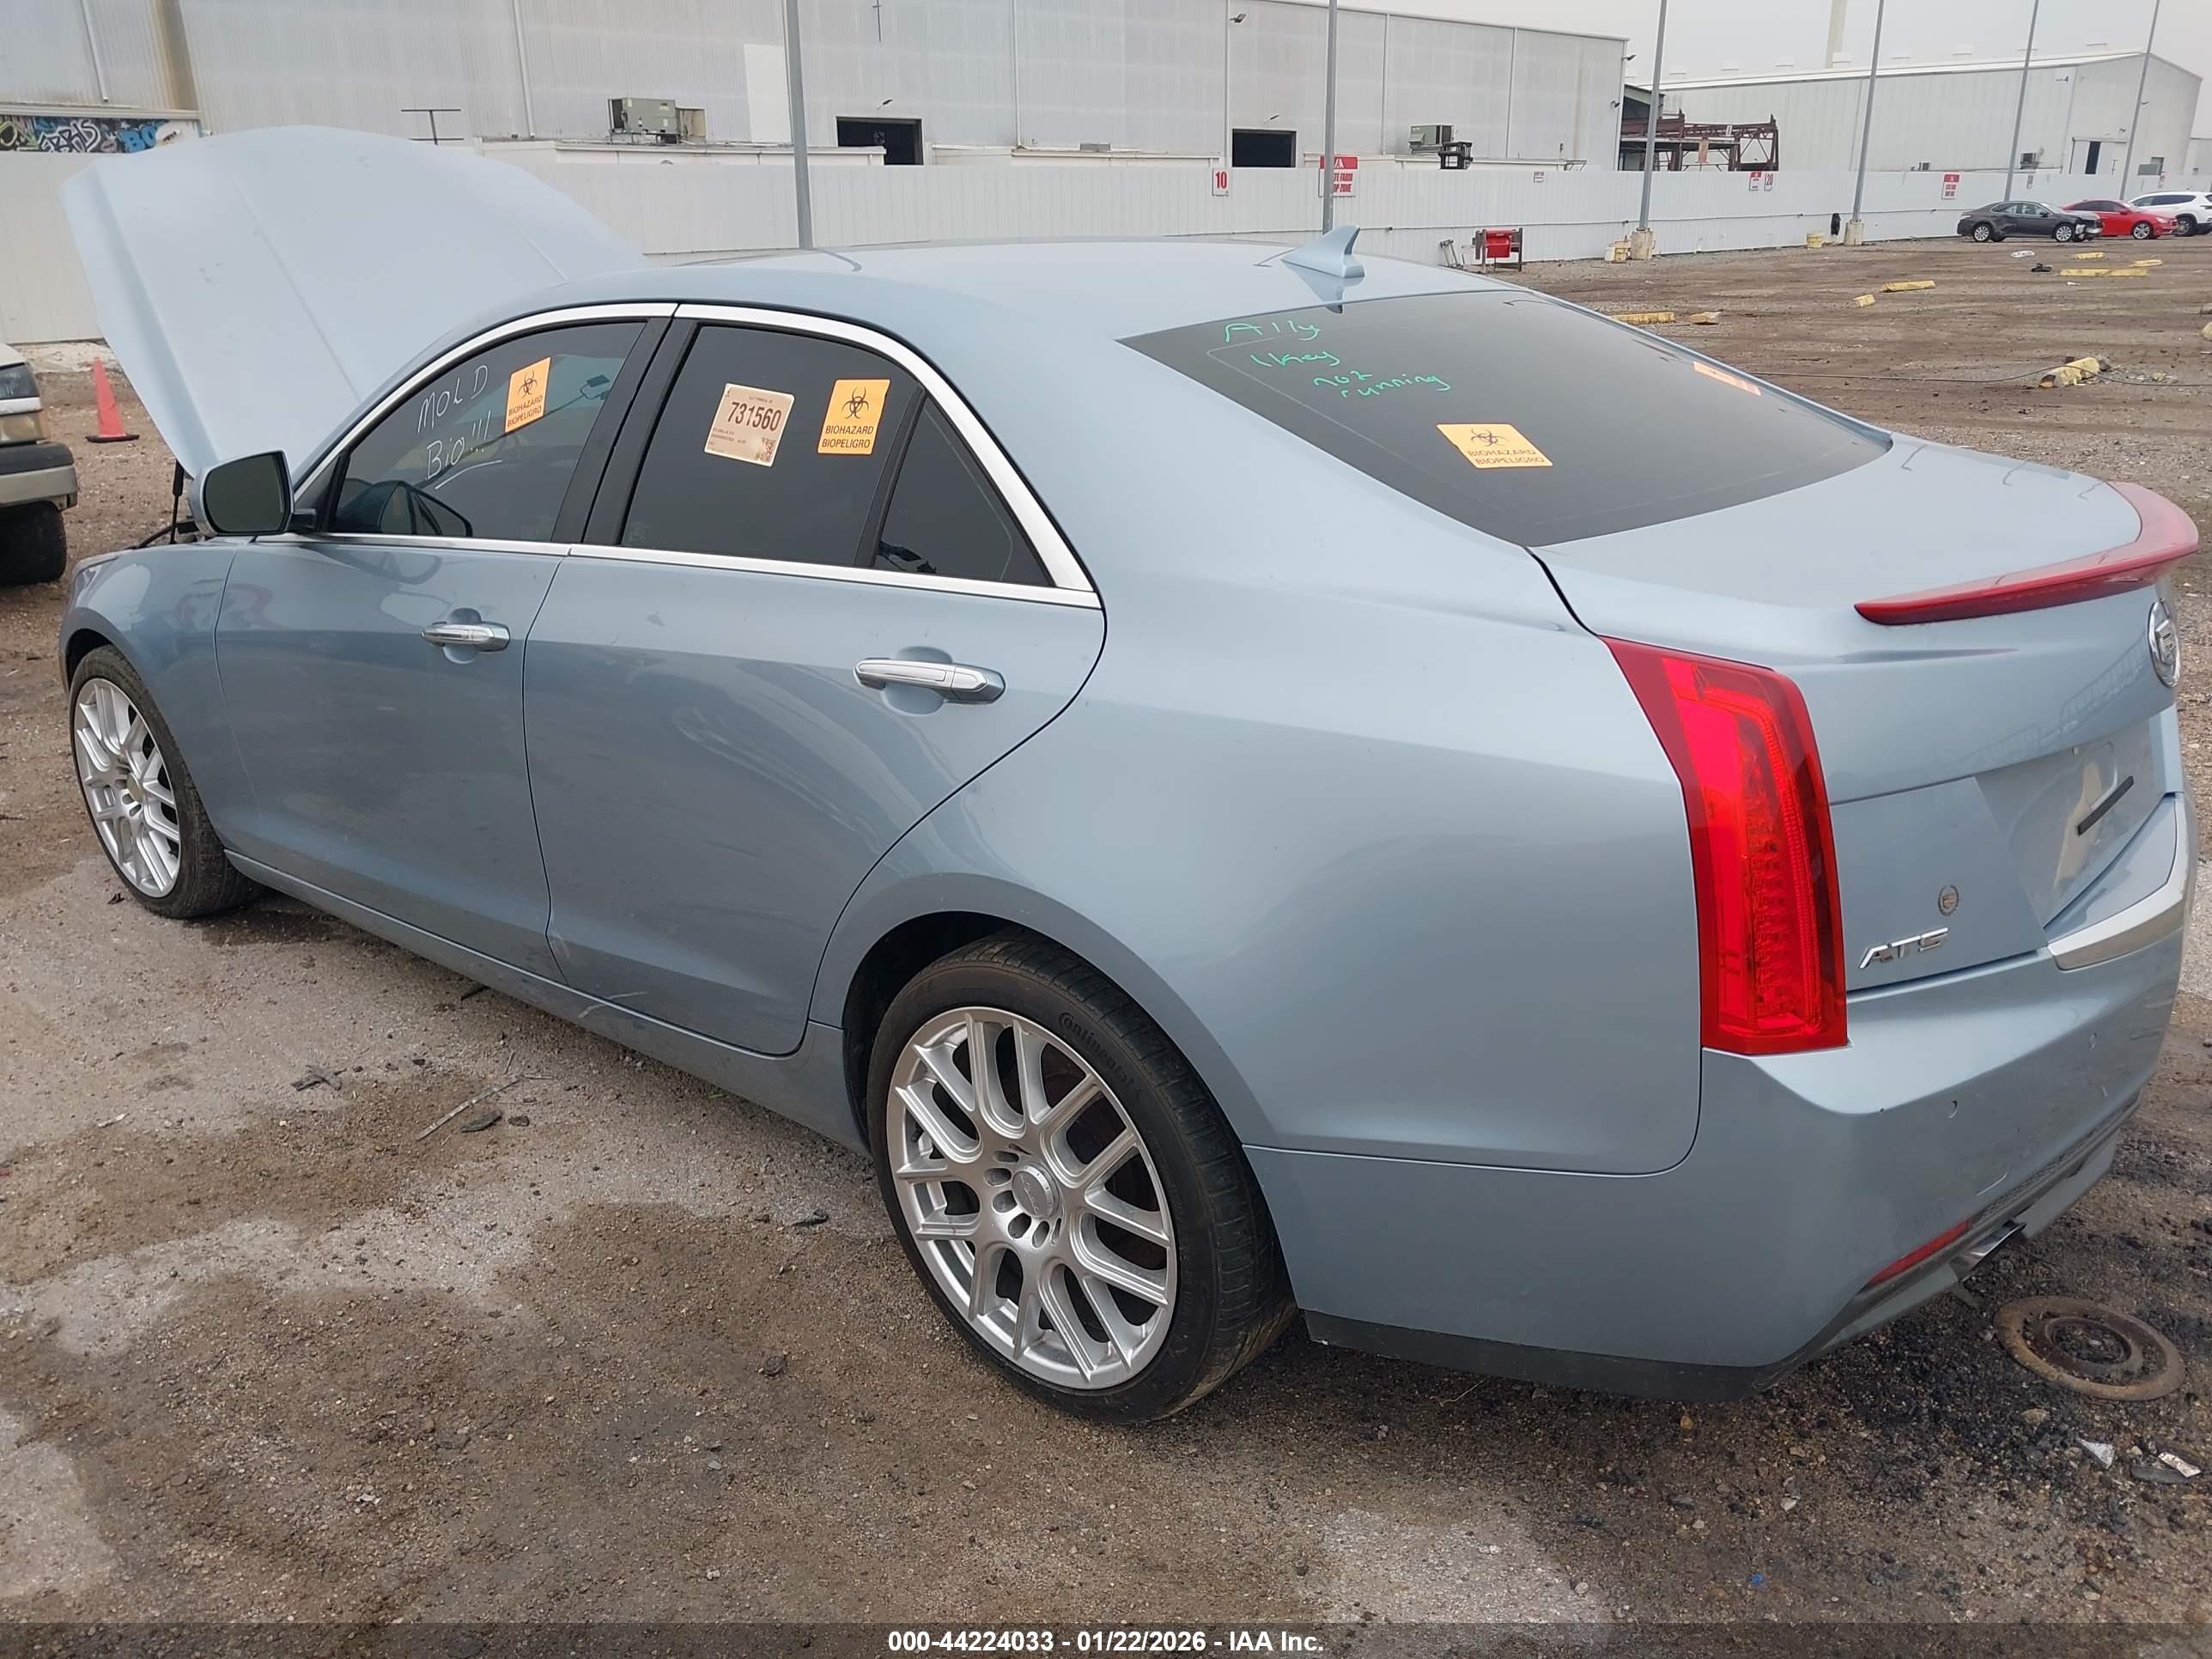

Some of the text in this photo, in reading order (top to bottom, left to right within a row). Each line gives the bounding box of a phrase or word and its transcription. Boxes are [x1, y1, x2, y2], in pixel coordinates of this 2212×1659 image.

[1215, 172, 1227, 189] 10
[1225, 320, 1320, 343] Ally
[1313, 370, 1373, 386] not
[1341, 374, 1451, 398] running
[508, 395, 544, 416] BIOHAZARD
[507, 405, 542, 428] BIOPELIGRO
[727, 401, 782, 432] 731560
[825, 425, 874, 435] BIOHAZARD
[822, 439, 871, 448] BIOPELIGRO
[1475, 457, 1545, 465] BIOPELIGRO
[1859, 927, 1948, 969] ATS
